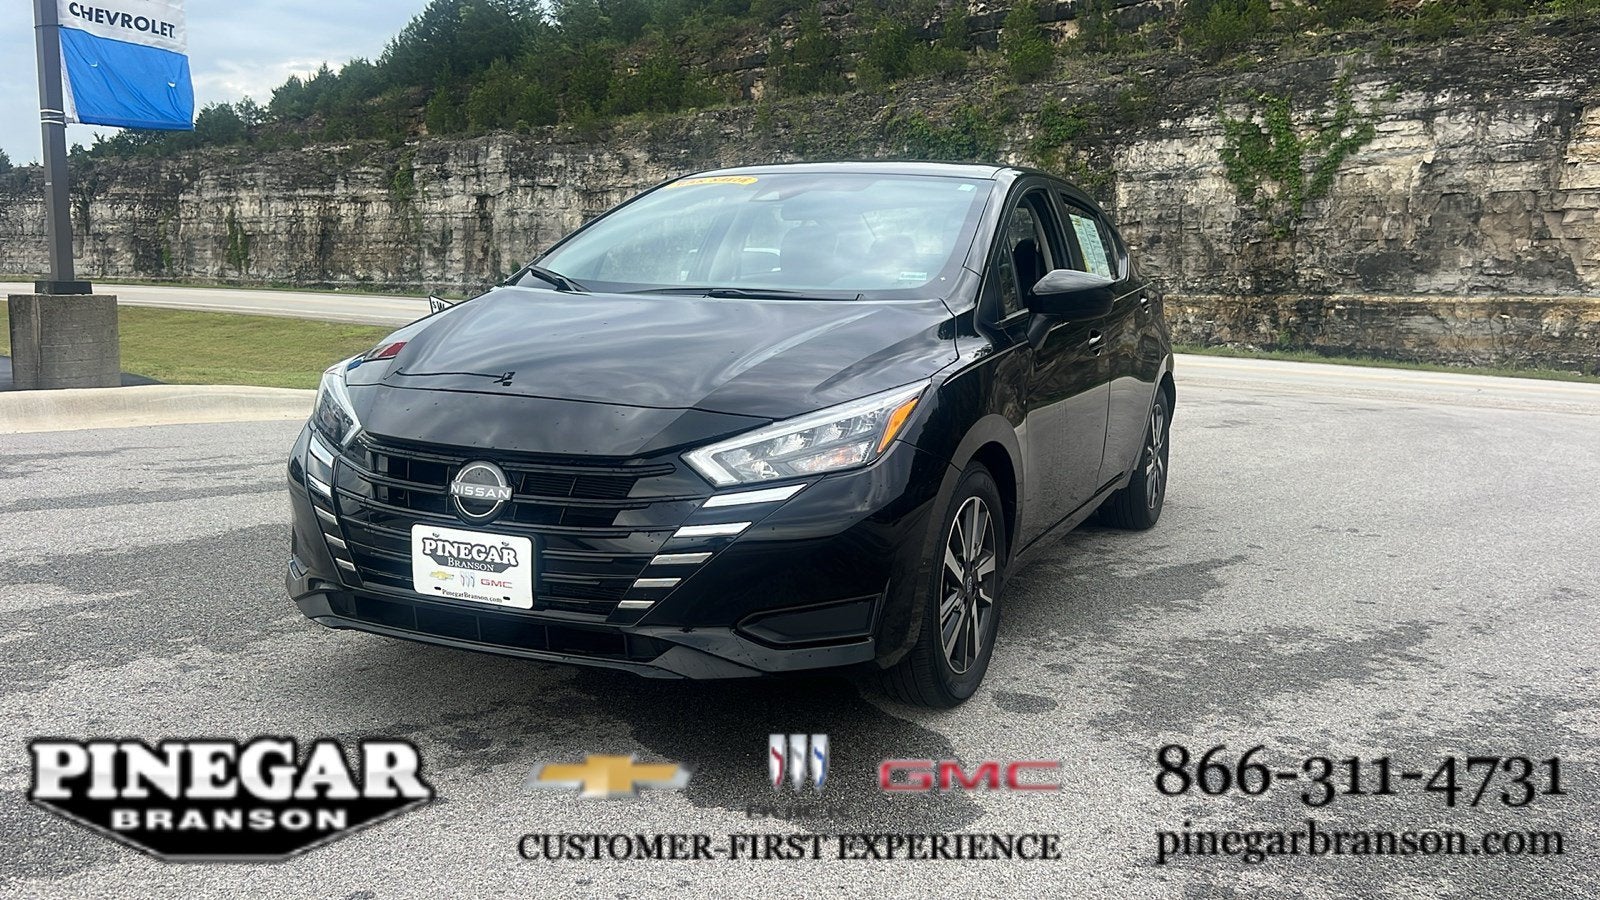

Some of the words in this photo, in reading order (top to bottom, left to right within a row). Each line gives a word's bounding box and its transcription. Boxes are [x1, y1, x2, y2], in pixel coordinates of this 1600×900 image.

[69, 2, 176, 39] CHEVROLET
[451, 483, 511, 499] NISSAN
[422, 537, 519, 567] PINEGAR
[480, 578, 513, 589] GMC
